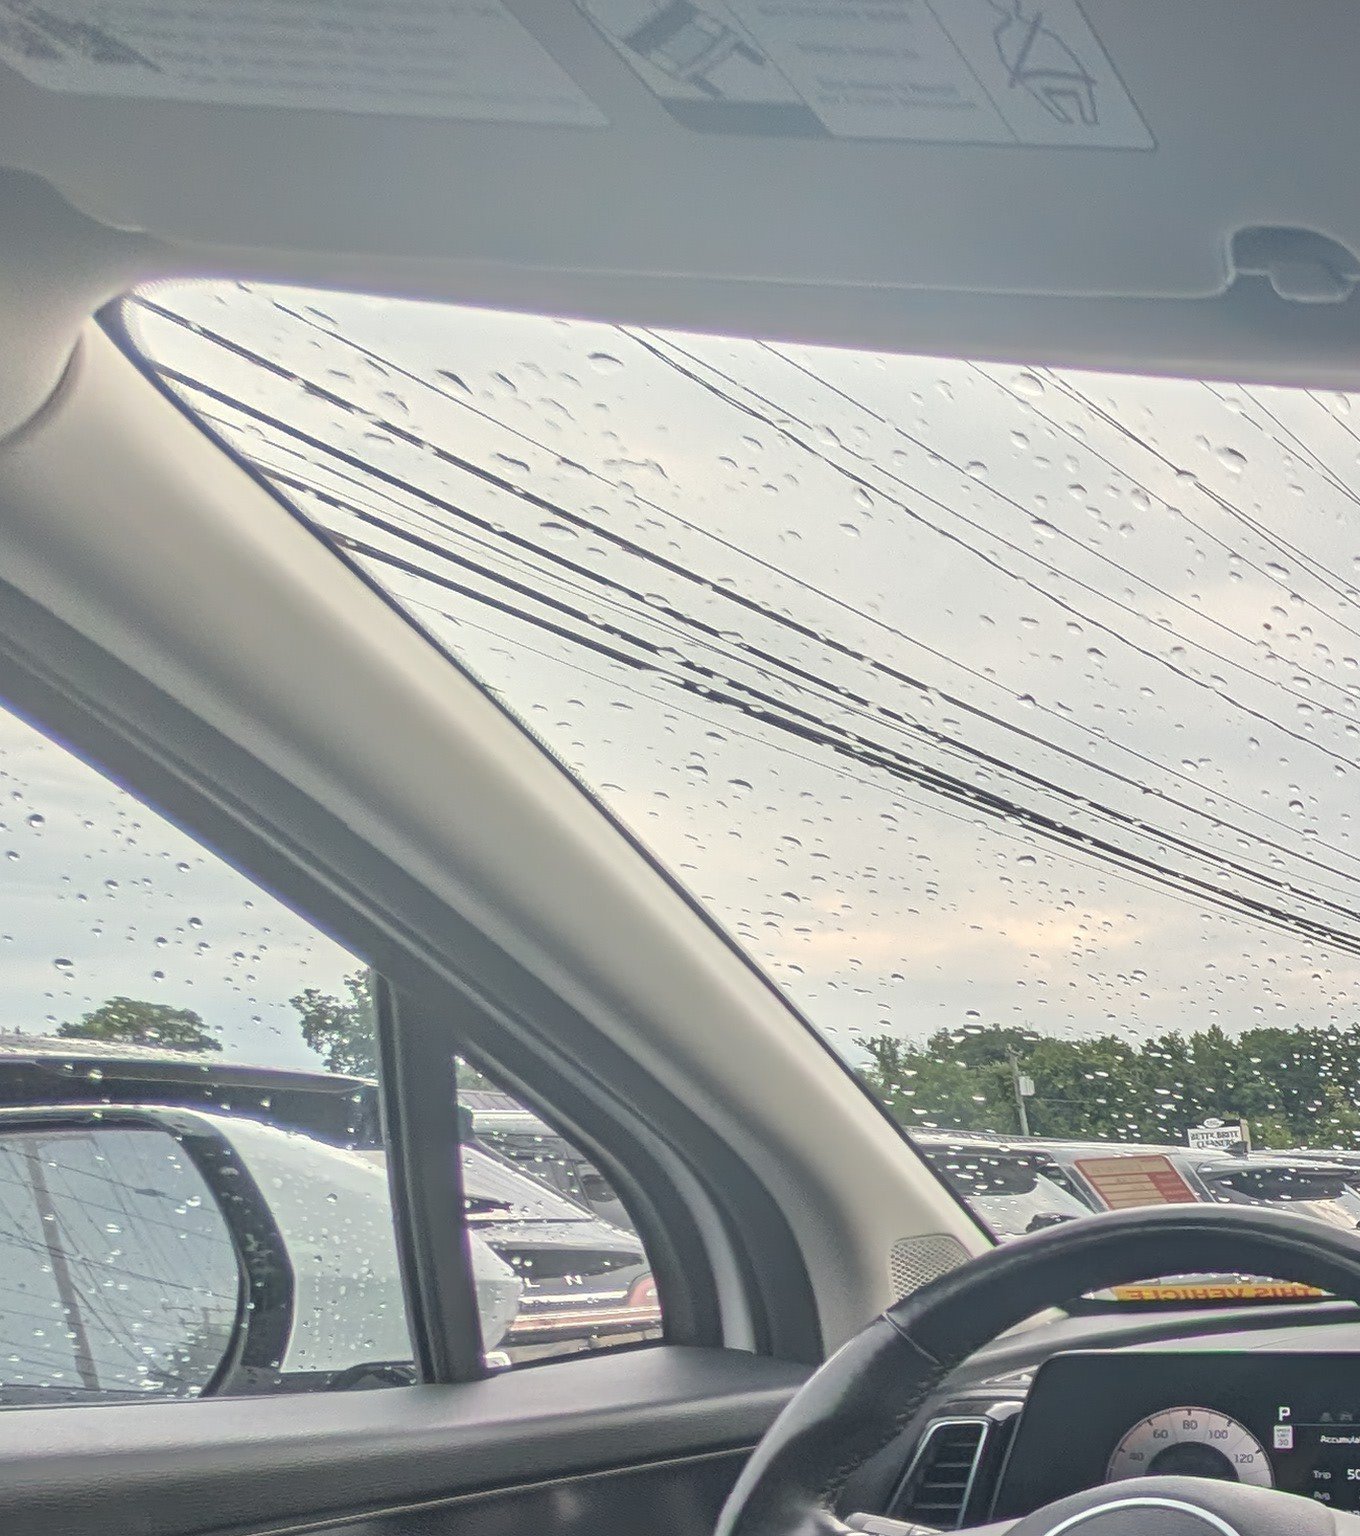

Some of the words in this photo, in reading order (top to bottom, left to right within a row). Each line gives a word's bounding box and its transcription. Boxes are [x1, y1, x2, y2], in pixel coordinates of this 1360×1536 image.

[1278, 1406, 1291, 1422] P
[1182, 1420, 1199, 1430] 80
[1153, 1430, 1169, 1440] 60
[1208, 1429, 1229, 1440] 100
[1234, 1453, 1255, 1464] 120
[1313, 1469, 1332, 1481] Trip
